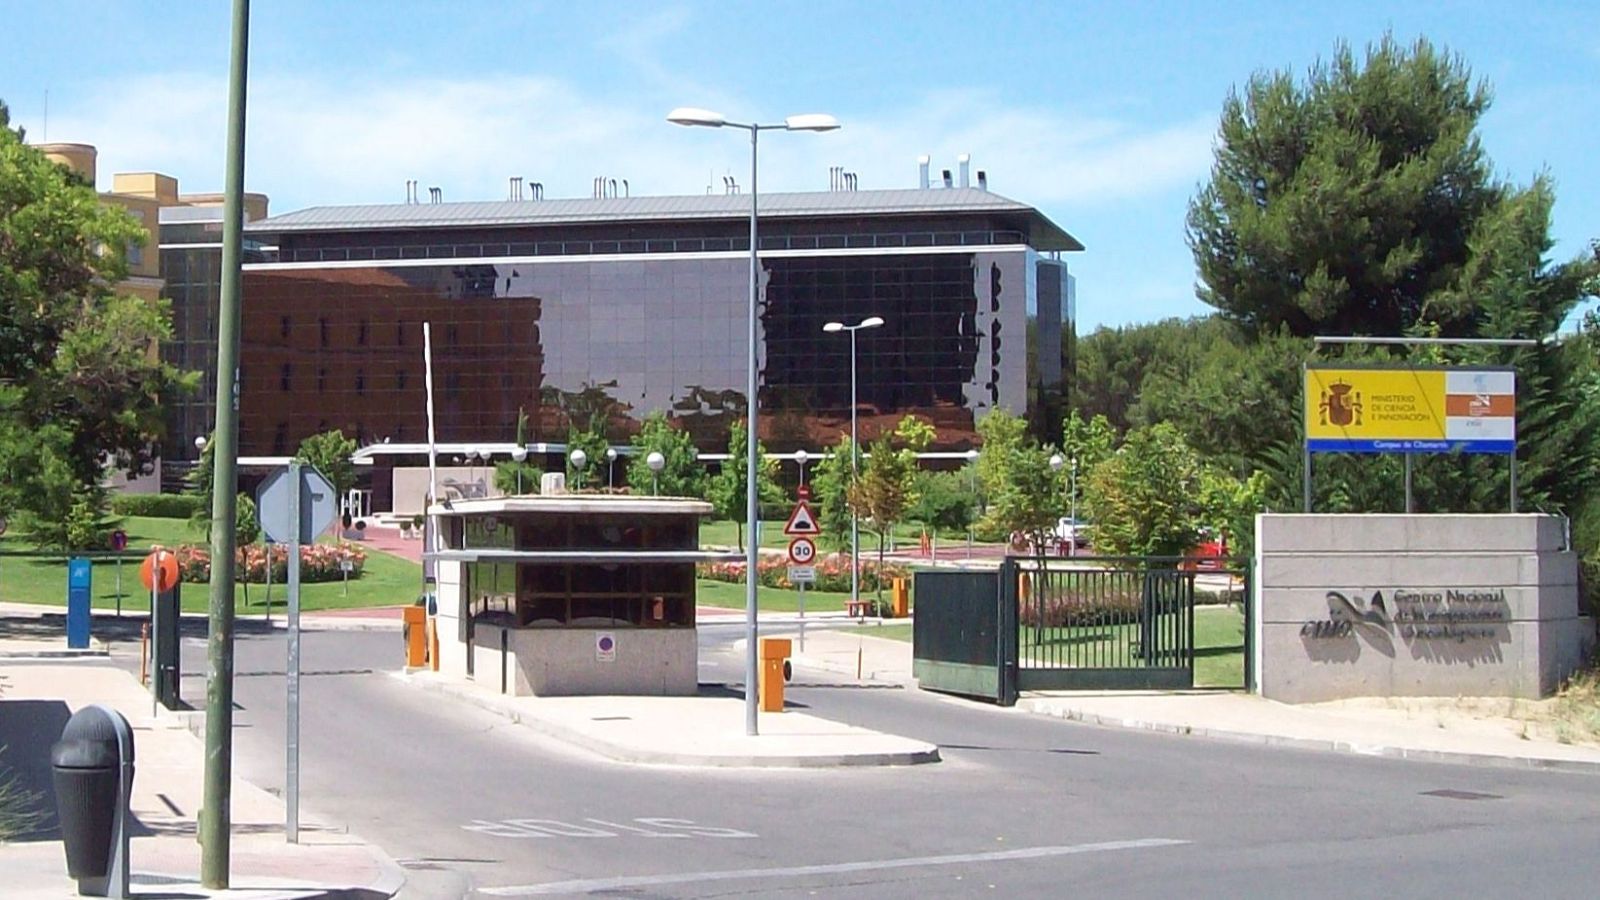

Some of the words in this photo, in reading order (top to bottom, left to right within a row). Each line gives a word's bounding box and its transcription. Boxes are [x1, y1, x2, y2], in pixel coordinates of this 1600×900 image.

[794, 546, 810, 556] 30
[1394, 589, 1442, 603] Centro
[1446, 588, 1504, 603] Nacional
